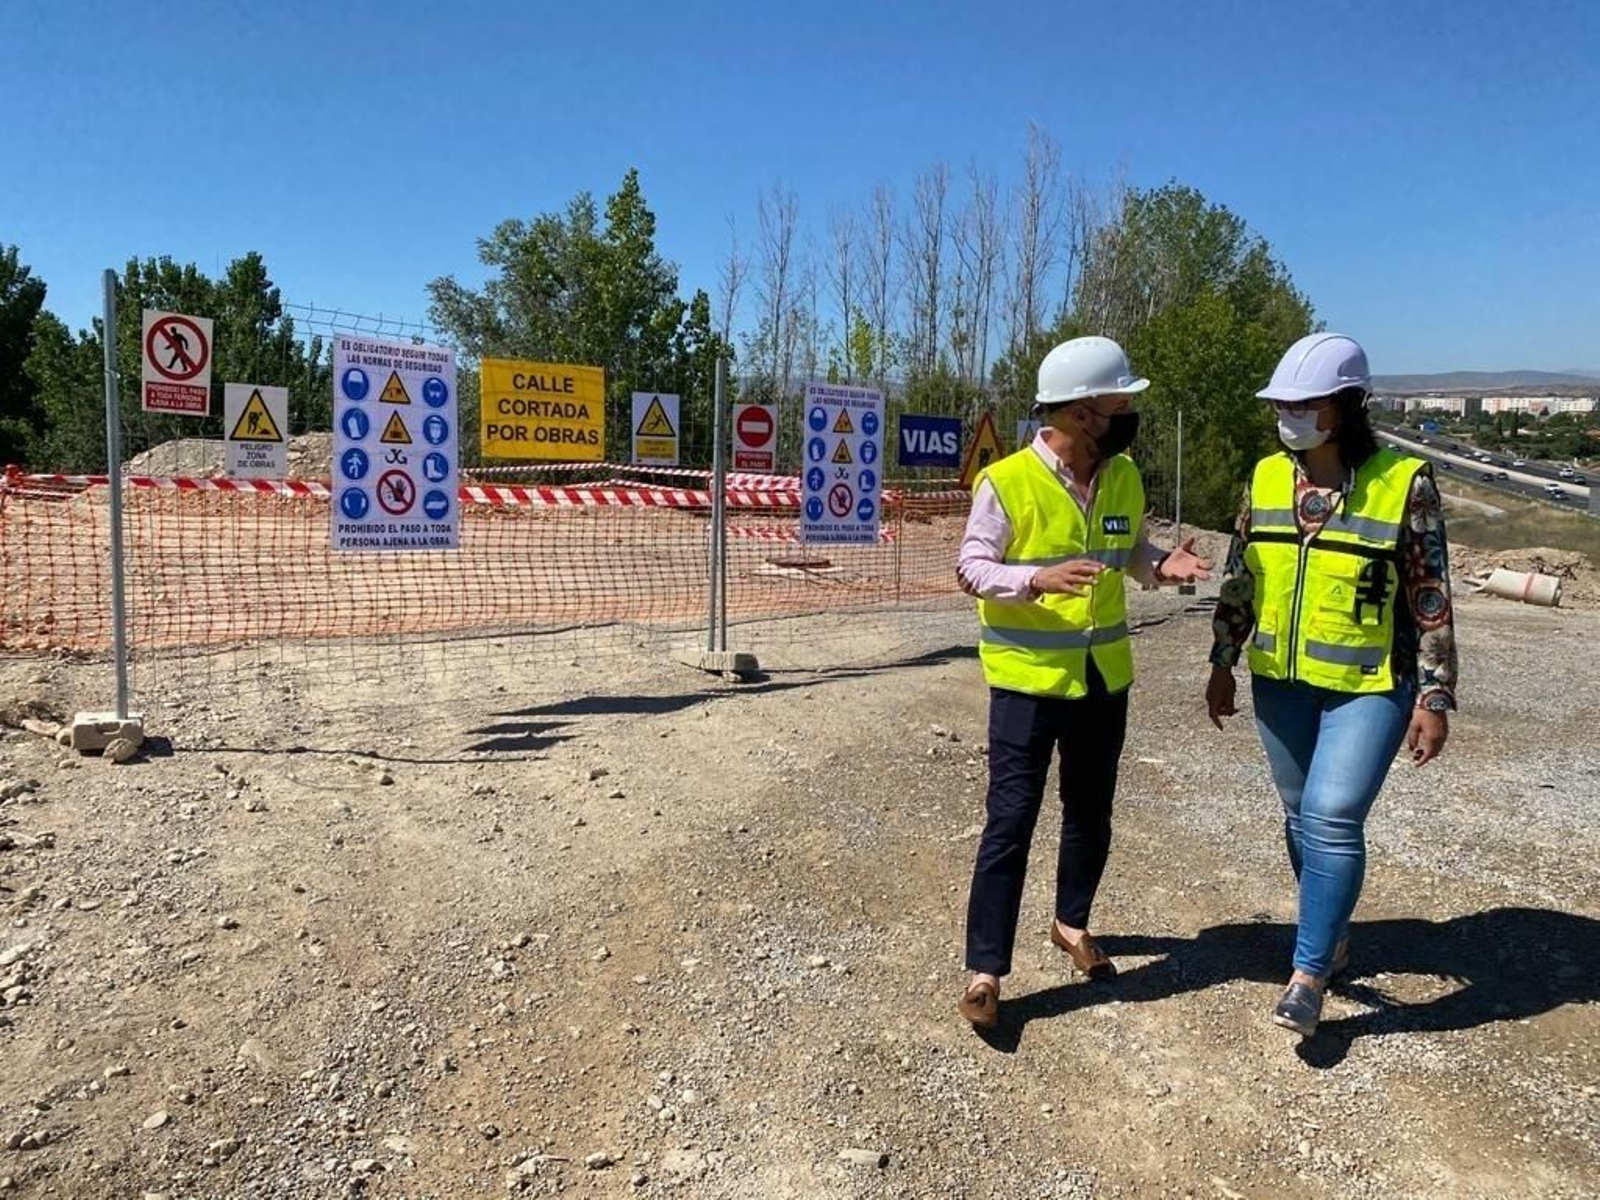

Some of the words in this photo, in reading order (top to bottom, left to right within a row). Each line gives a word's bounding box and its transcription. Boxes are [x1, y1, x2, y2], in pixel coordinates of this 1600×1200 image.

[341, 340, 351, 350] ES
[352, 341, 401, 356] OBLIGATORIO
[401, 348, 426, 360] SEGUIR
[428, 351, 448, 362] TODAS
[347, 354, 361, 364] LAS
[362, 356, 392, 368] NORMAS
[394, 360, 402, 369] DE
[405, 360, 442, 373] SEGURIDAD
[512, 374, 575, 393] CALLE
[498, 398, 590, 420] CORTADA
[486, 424, 528, 442] POR
[534, 426, 600, 444] OBRAS
[902, 428, 958, 454] VIAS
[240, 443, 274, 451] PELIGRO
[246, 452, 268, 460] ZONA
[250, 460, 276, 468] OBRAS
[338, 524, 386, 534] PROHIBIDO
[388, 524, 398, 534] EL
[400, 524, 420, 534] PASO
[422, 524, 429, 534] A
[431, 524, 452, 534] TODA
[340, 538, 380, 548] PERSONA
[382, 538, 410, 546] AJENA
[410, 538, 417, 546] A
[418, 538, 428, 546] LA
[430, 537, 450, 546] OBRA
